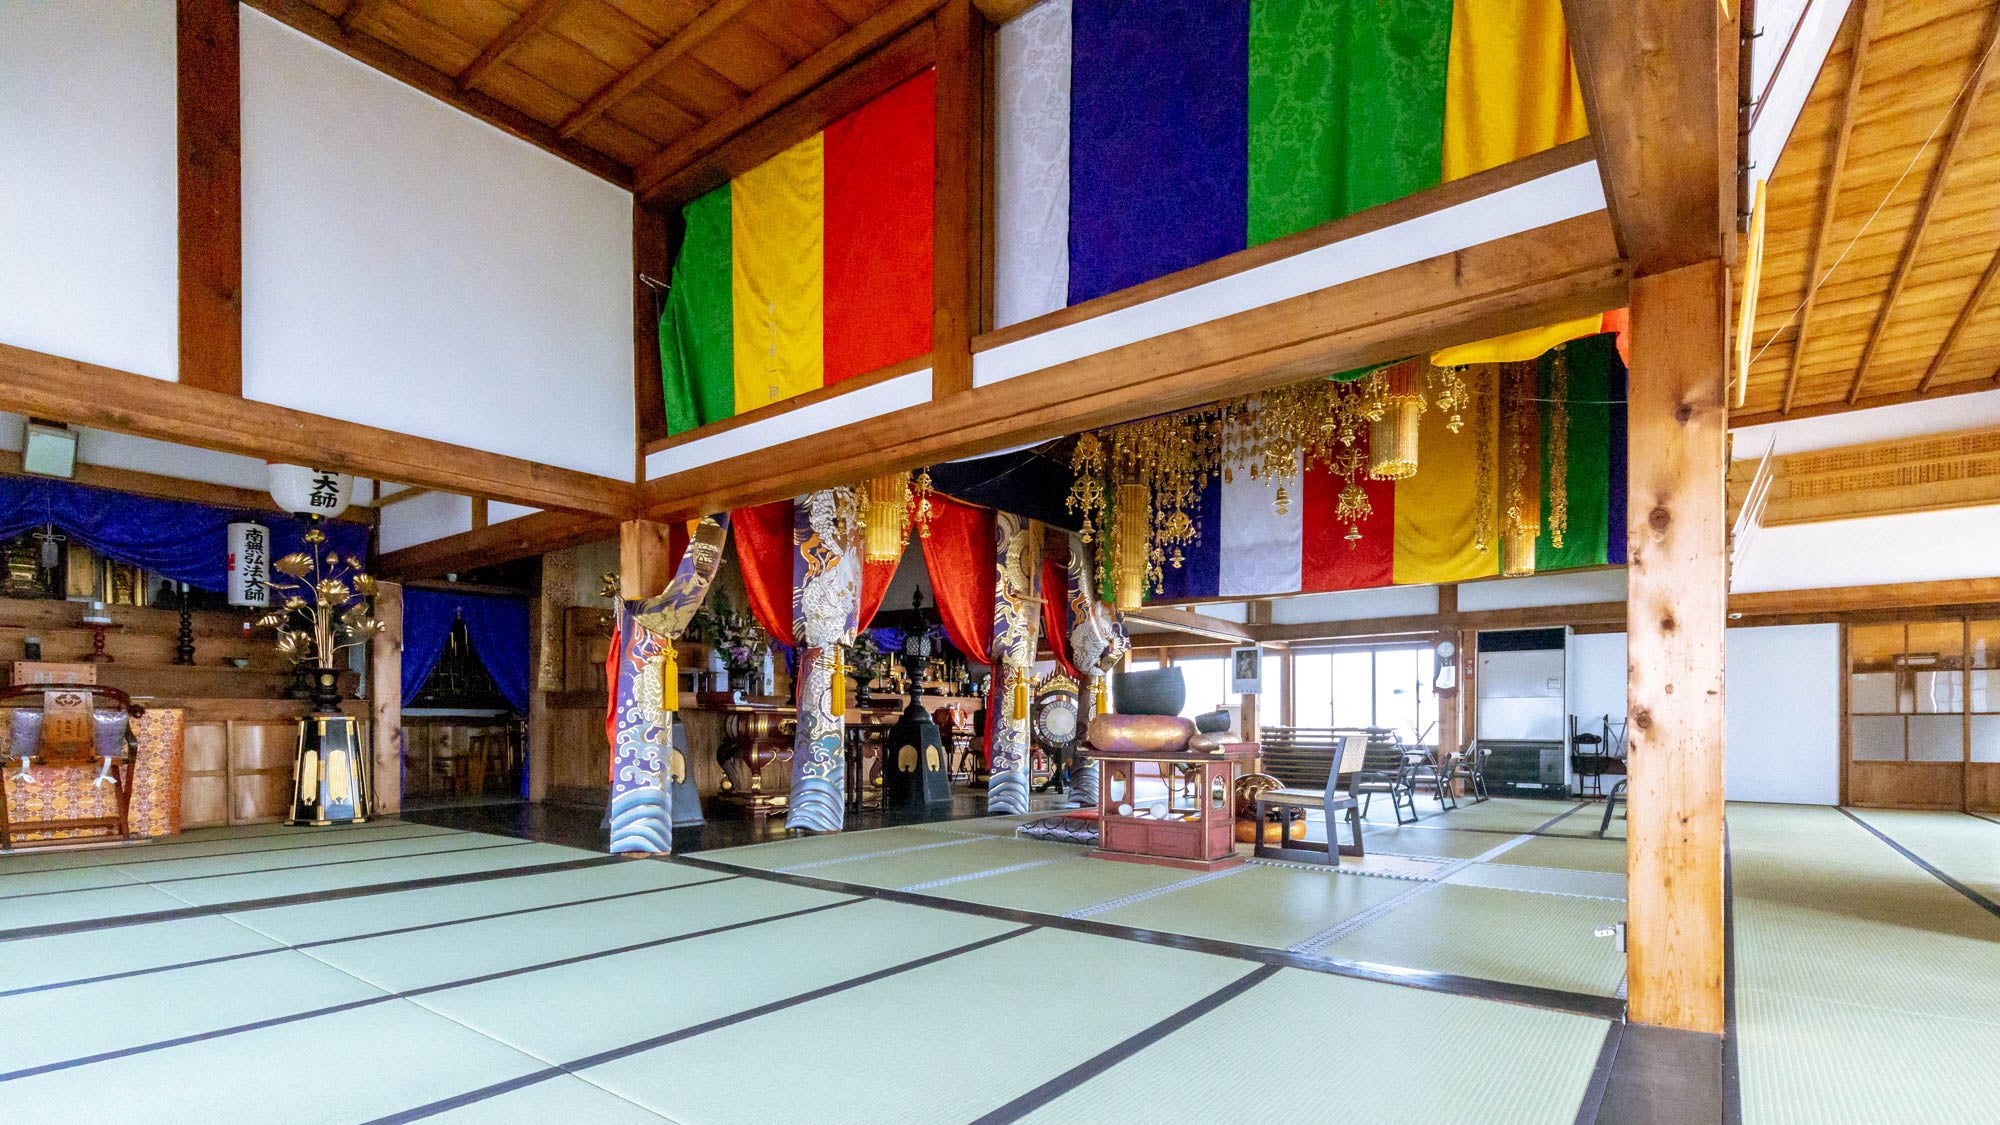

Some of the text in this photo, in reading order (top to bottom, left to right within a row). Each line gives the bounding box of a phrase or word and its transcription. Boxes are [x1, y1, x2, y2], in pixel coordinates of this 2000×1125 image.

[309, 468, 339, 508] 大師
[243, 528, 264, 601] 南無弘法大師
